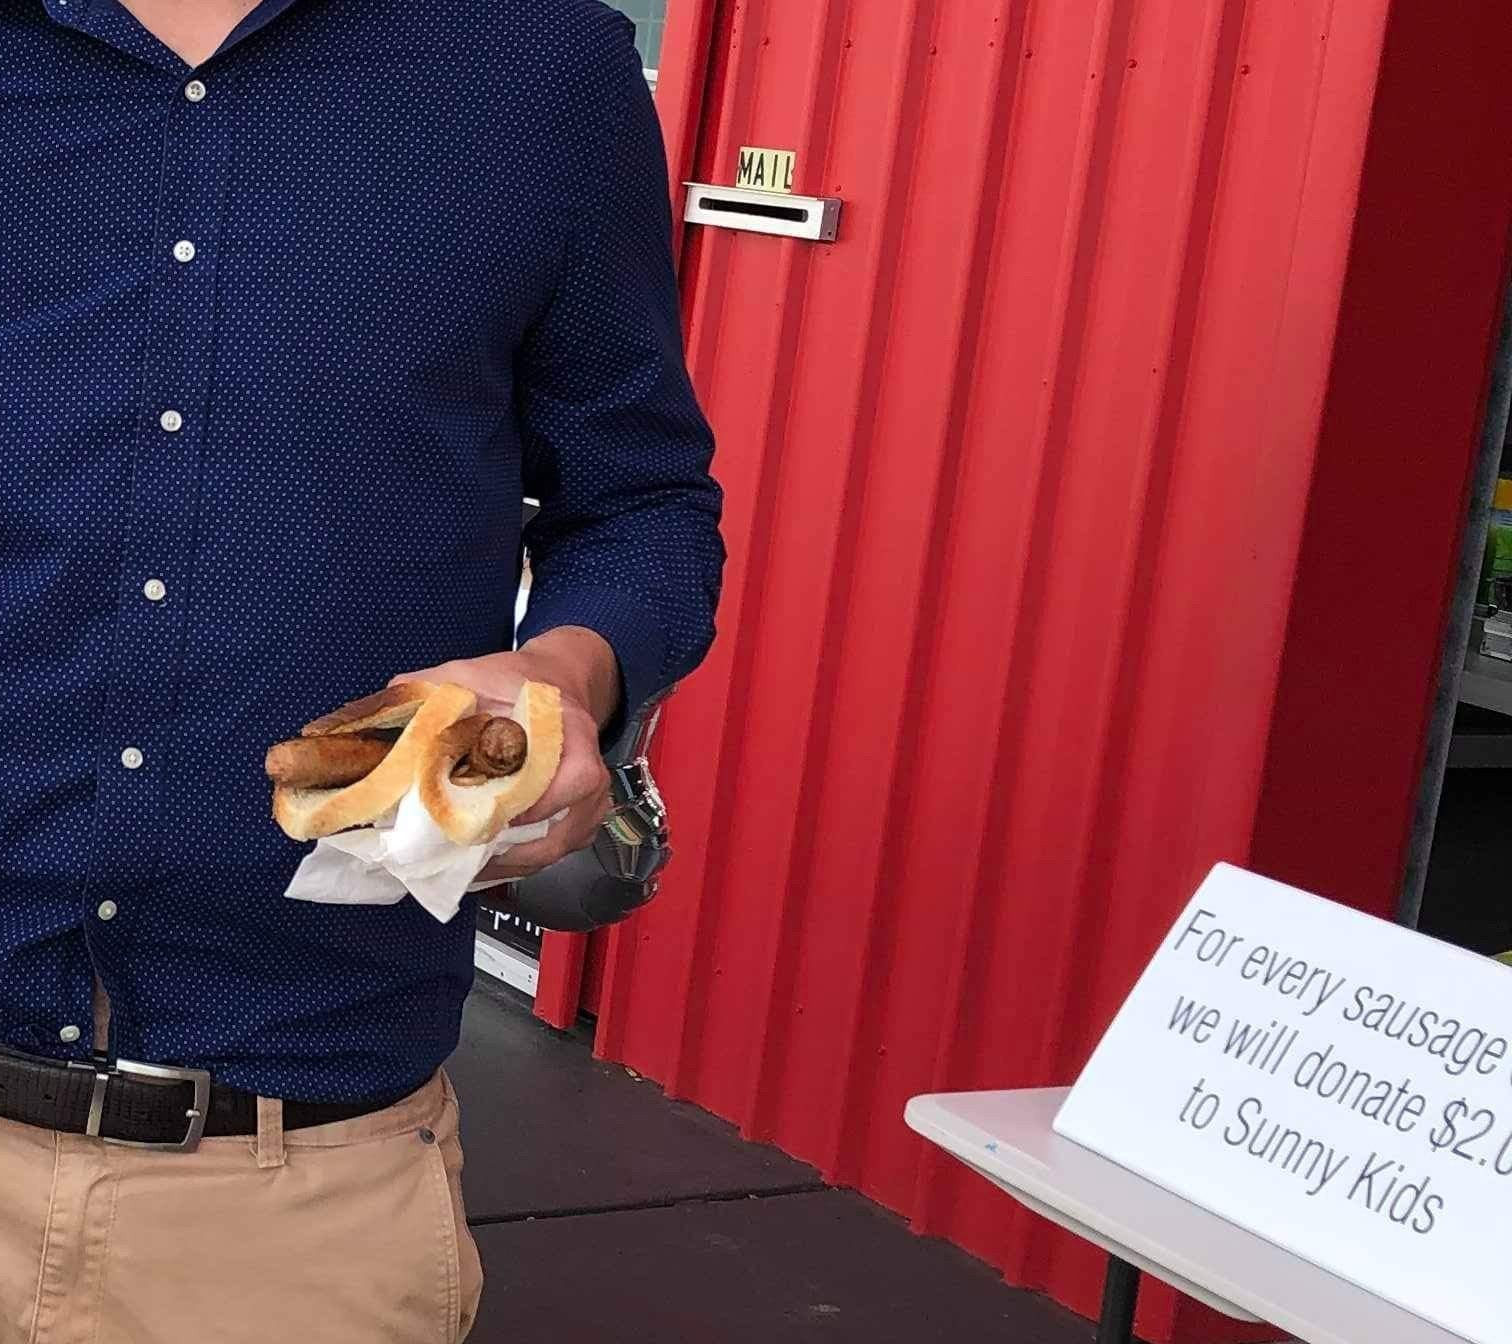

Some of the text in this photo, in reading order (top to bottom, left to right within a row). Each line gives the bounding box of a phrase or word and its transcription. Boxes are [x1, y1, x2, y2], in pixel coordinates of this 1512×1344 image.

[738, 151, 792, 189] MAIL
[1167, 995, 1221, 1044] we
[1223, 1019, 1299, 1075] will
[1292, 1043, 1427, 1133] donate
[1173, 908, 1508, 1076] For every sausage
[1178, 1077, 1445, 1234] to Sunny Kids
